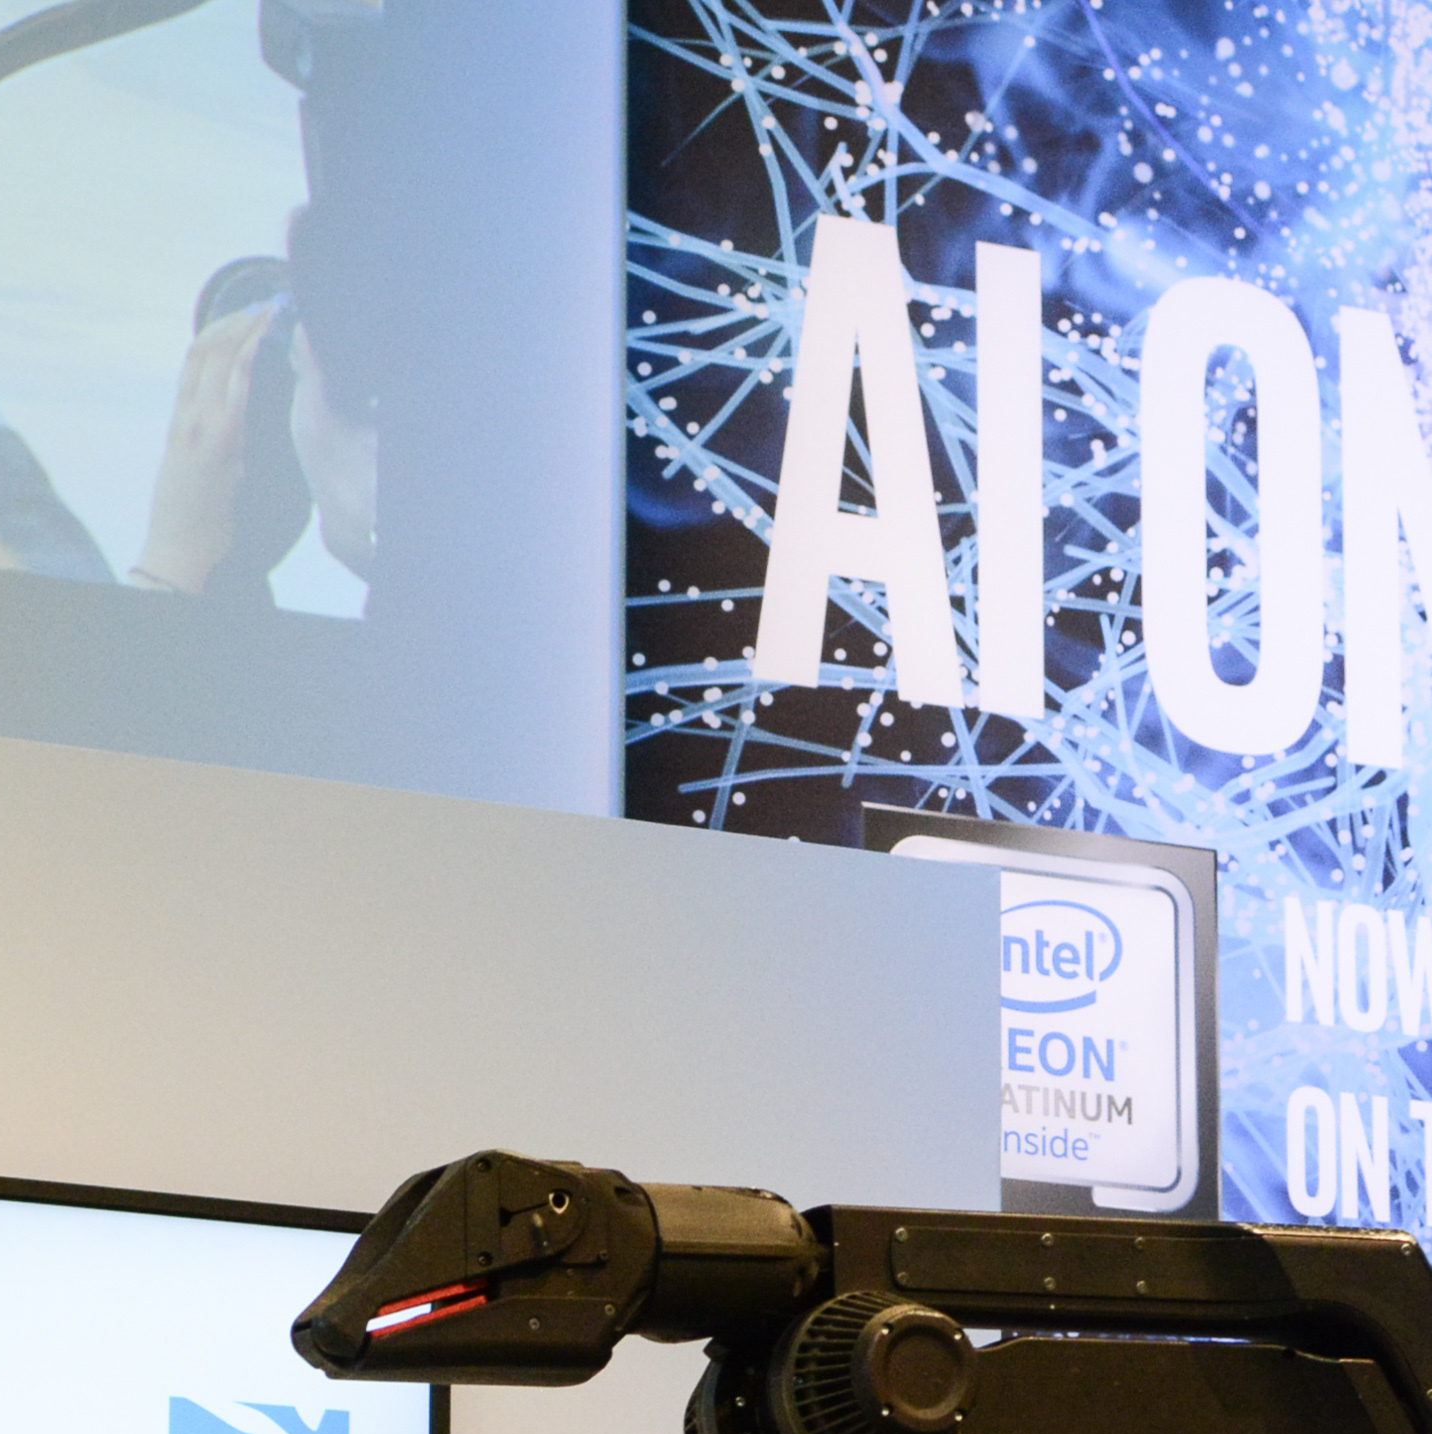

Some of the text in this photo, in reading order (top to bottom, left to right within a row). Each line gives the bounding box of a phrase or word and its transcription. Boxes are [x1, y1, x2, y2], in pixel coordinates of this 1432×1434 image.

[752, 212, 1046, 720] AI
[1002, 928, 1094, 982] ntel
[1006, 1027, 1115, 1082] EON
[1001, 1082, 1134, 1126] ATINUM
[1285, 1086, 1391, 1223] ON
